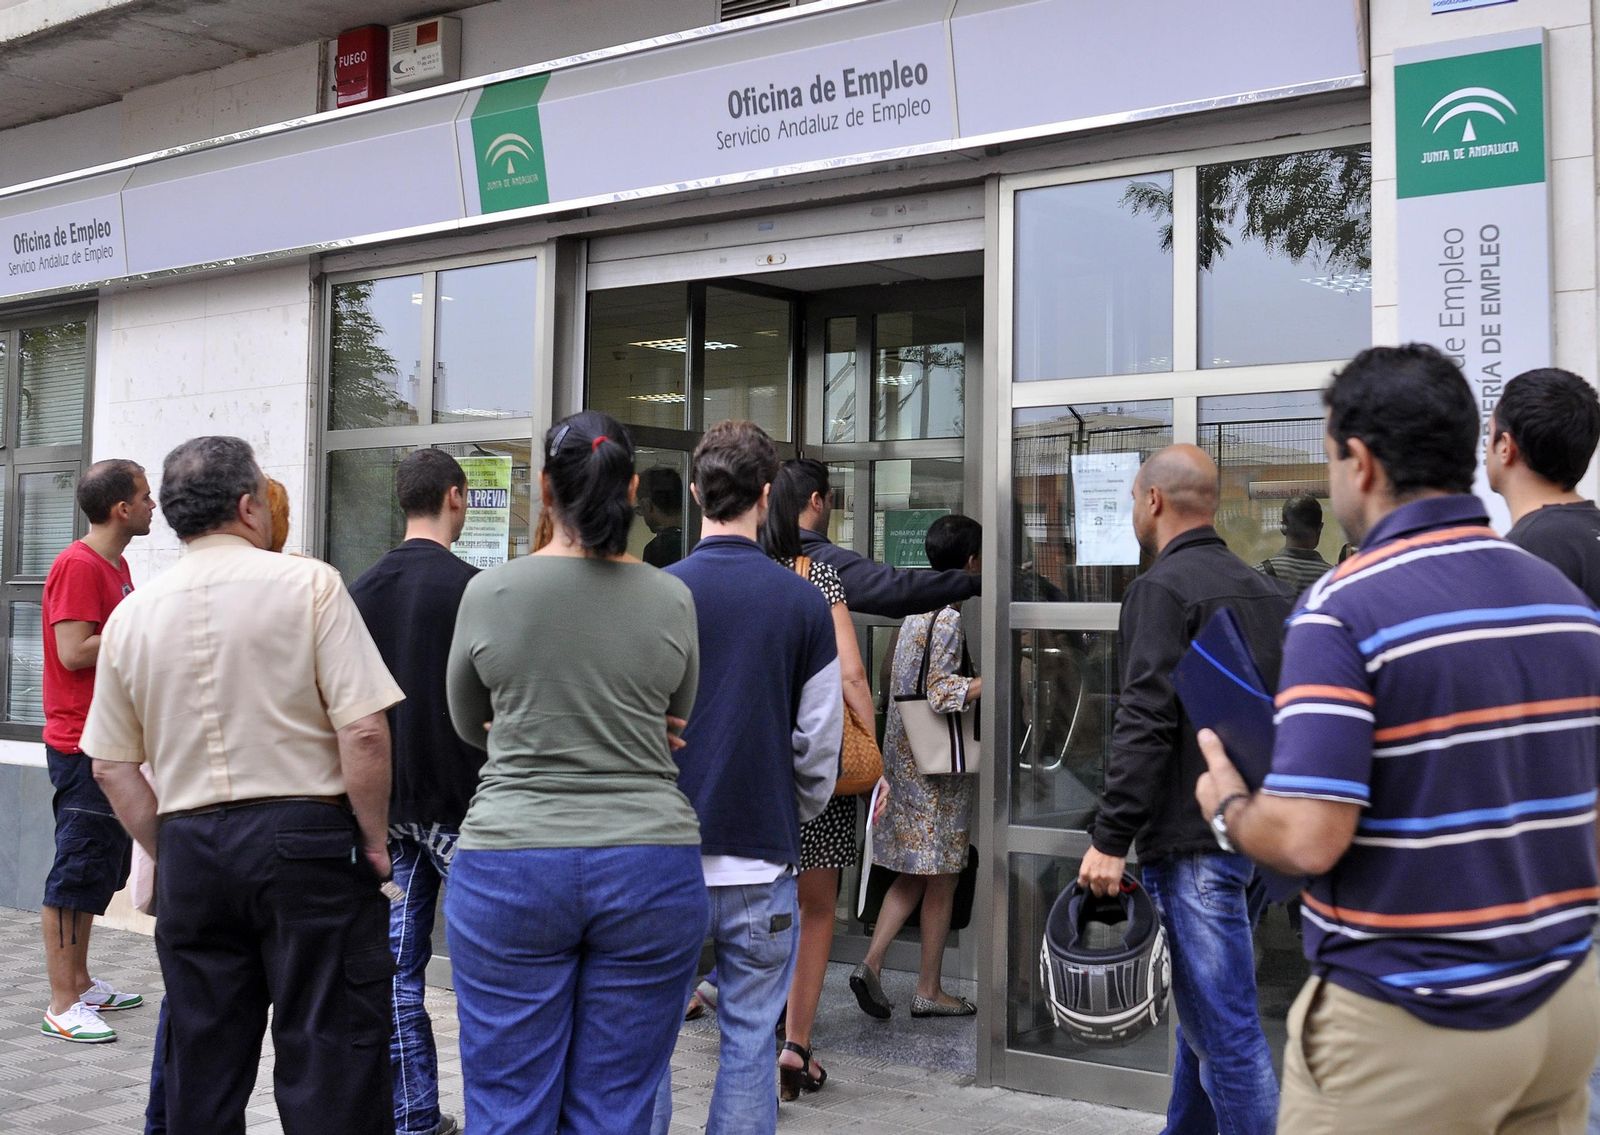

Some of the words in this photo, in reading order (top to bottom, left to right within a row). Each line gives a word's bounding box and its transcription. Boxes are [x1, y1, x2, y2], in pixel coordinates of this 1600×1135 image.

[339, 50, 367, 68] FUEGO
[728, 84, 803, 119] Oficina
[810, 74, 836, 104] de
[843, 59, 928, 99] Empleo
[716, 124, 770, 150] Servicio
[777, 113, 839, 139] Andaluz
[846, 107, 864, 128] de
[872, 97, 931, 125] Empleo
[1421, 149, 1450, 164] JUNTA
[1453, 147, 1465, 160] DE
[1468, 141, 1519, 158] ANDALUCIA
[13, 231, 51, 254] Oficina
[53, 226, 67, 246] de
[70, 218, 111, 245] Empleo
[8, 260, 35, 276] Servicio
[39, 253, 69, 270] Andaluz
[71, 250, 82, 265] de
[84, 245, 113, 264] Empleo
[1479, 224, 1501, 316] EMPLEO
[1438, 228, 1473, 327] Empleo
[1481, 324, 1502, 354] DE
[474, 490, 506, 507] PREVIA
